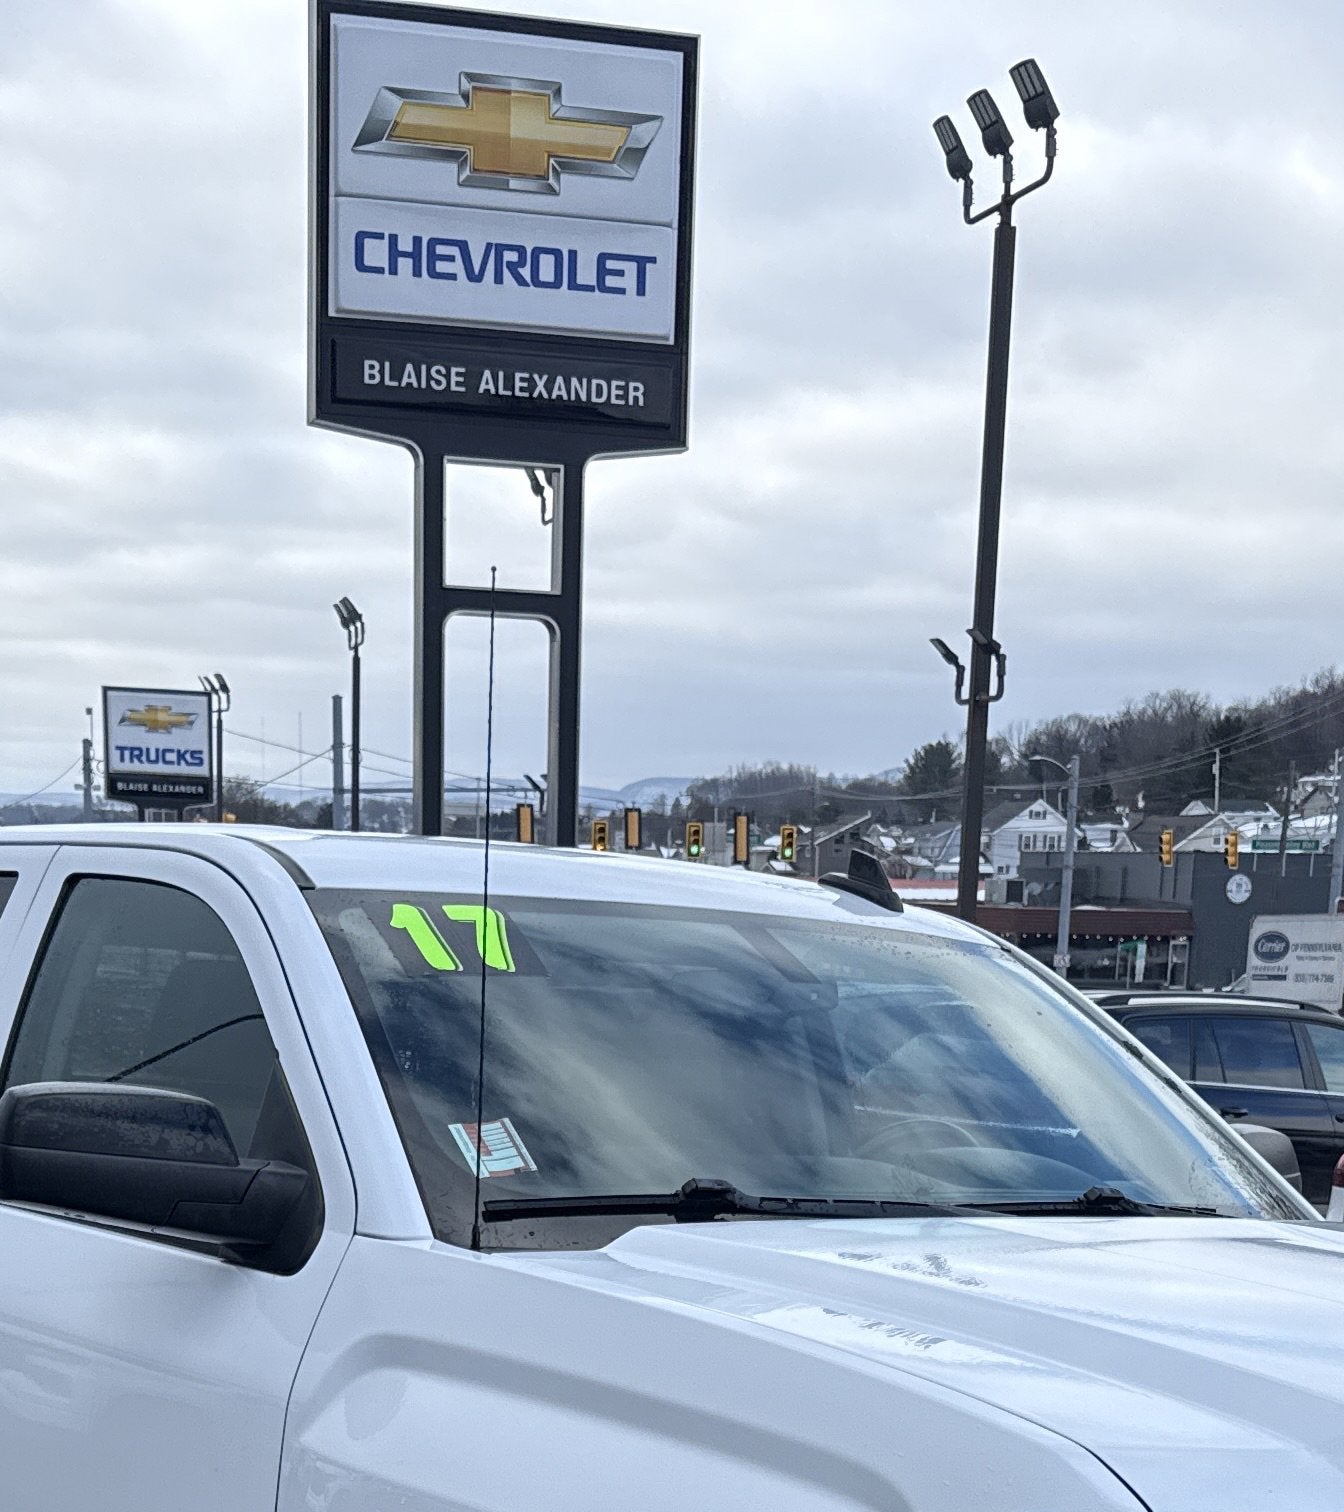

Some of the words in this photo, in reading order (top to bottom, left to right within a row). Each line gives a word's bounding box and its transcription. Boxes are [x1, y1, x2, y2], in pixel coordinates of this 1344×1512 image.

[354, 229, 657, 297] CHEVROLET
[362, 359, 467, 394] BLAISE
[478, 369, 646, 407] ALEXANDER
[115, 745, 205, 768] TRUCKS
[117, 781, 149, 792] BLAISE
[152, 783, 204, 795] ALEXANDER
[389, 903, 516, 973] 17
[1257, 938, 1286, 953] Carrier
